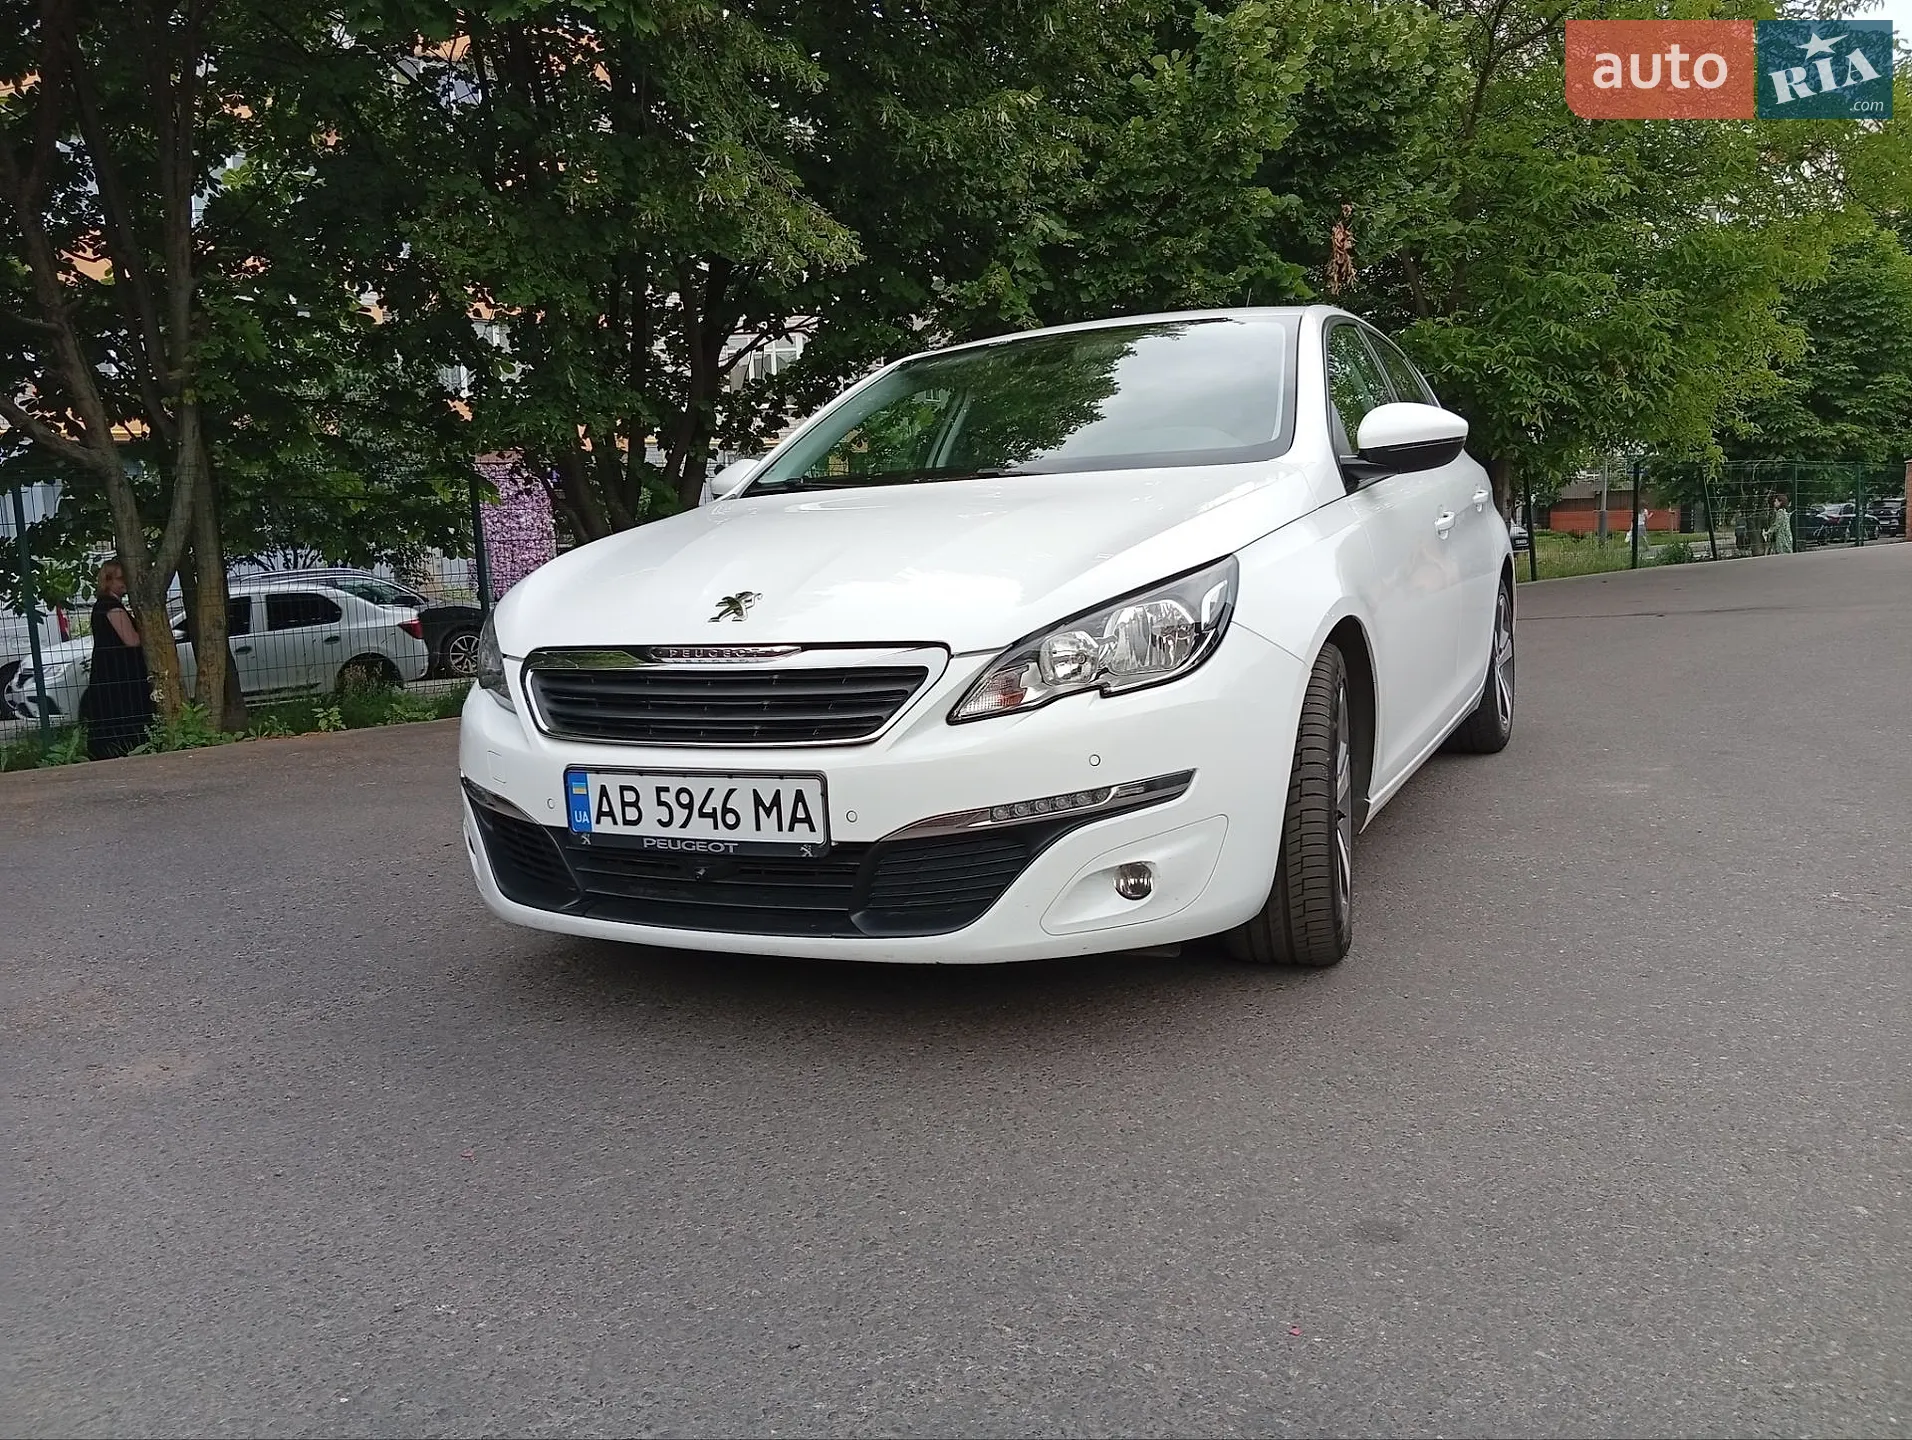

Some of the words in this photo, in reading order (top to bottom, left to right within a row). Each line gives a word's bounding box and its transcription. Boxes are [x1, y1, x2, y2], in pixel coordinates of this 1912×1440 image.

[669, 648, 761, 658] PEUGEOT
[595, 784, 643, 827] AB
[655, 786, 741, 830] 5946
[752, 788, 817, 833] MA
[574, 810, 590, 824] UA
[643, 837, 739, 854] PEUGEOT
